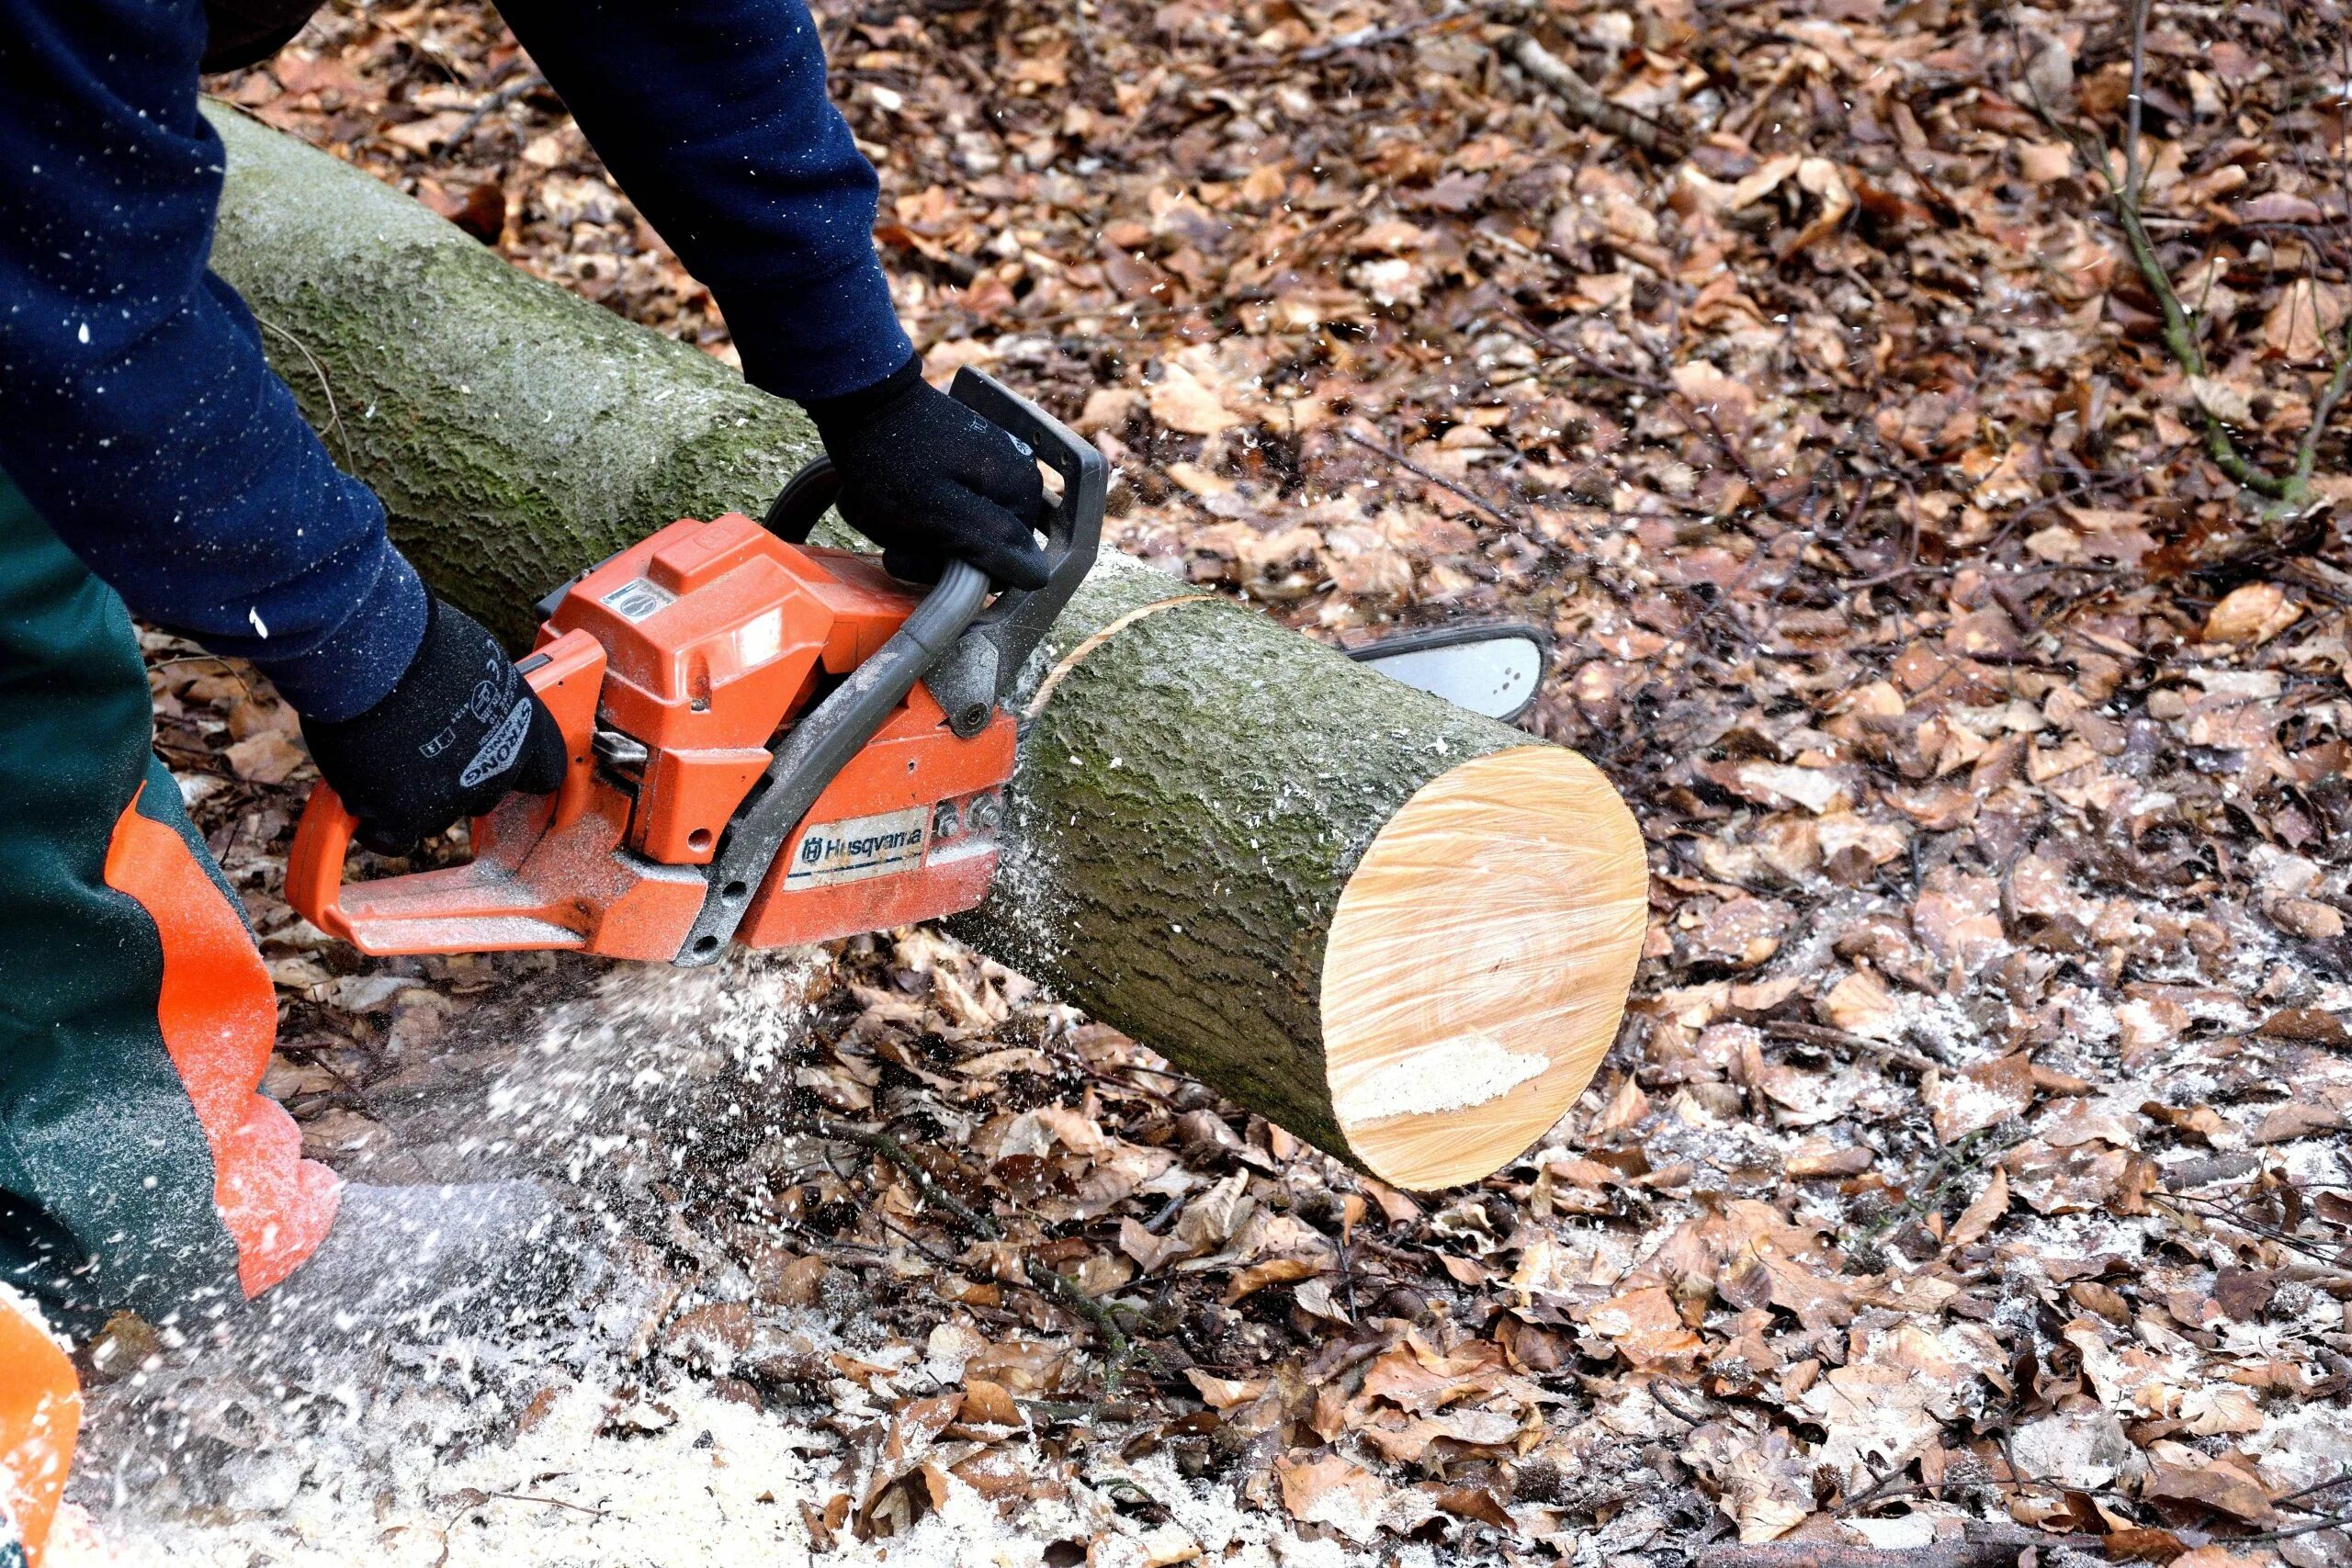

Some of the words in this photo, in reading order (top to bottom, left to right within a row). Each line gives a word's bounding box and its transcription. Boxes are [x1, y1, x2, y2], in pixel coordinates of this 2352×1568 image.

[464, 703, 530, 784] STRONG
[485, 721, 512, 754] HAND
[825, 829, 922, 859] Husqvarna
